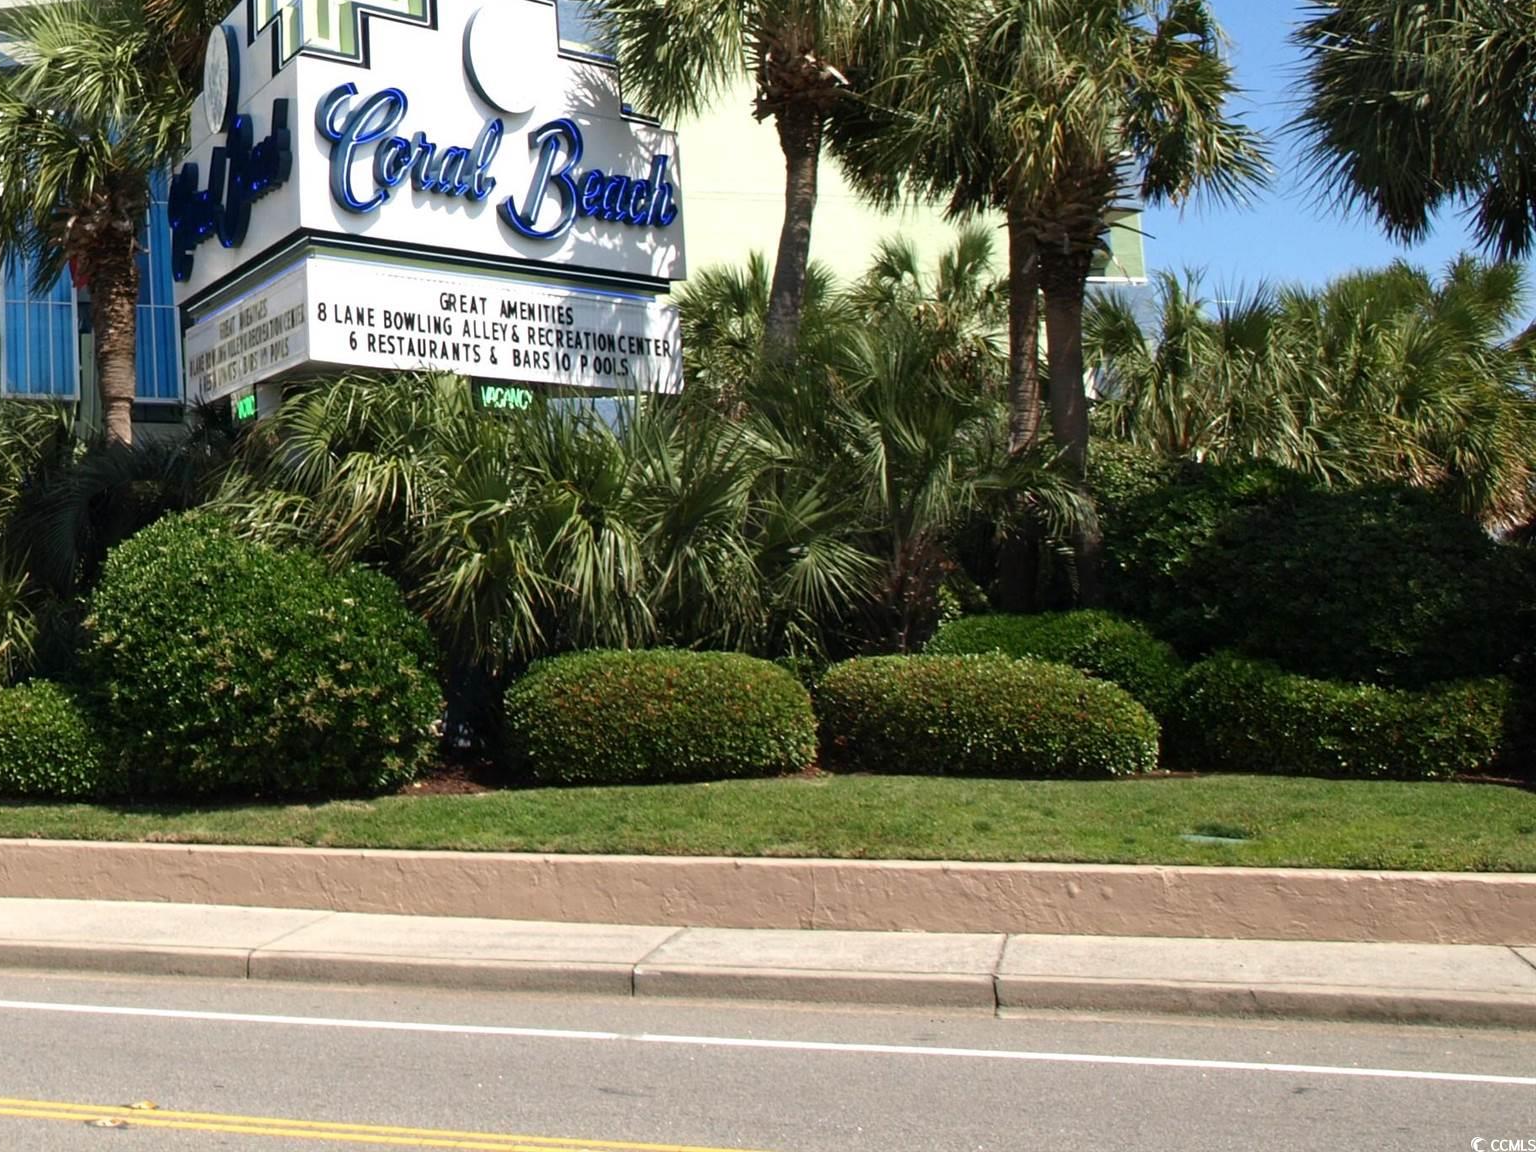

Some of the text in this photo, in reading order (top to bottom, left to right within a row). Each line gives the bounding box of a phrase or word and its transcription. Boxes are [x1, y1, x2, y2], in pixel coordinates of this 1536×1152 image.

[315, 82, 504, 215] Coral
[496, 118, 678, 240] Beach
[317, 302, 327, 322] 8
[334, 304, 375, 327] LANE
[383, 310, 453, 336] BOWLING
[439, 292, 574, 326] GREAT AMENITIES
[349, 331, 358, 351] 6
[367, 333, 482, 363] RESTAURANTS
[489, 346, 498, 365] &
[512, 349, 551, 370] BARS
[480, 385, 534, 410] VACANCY
